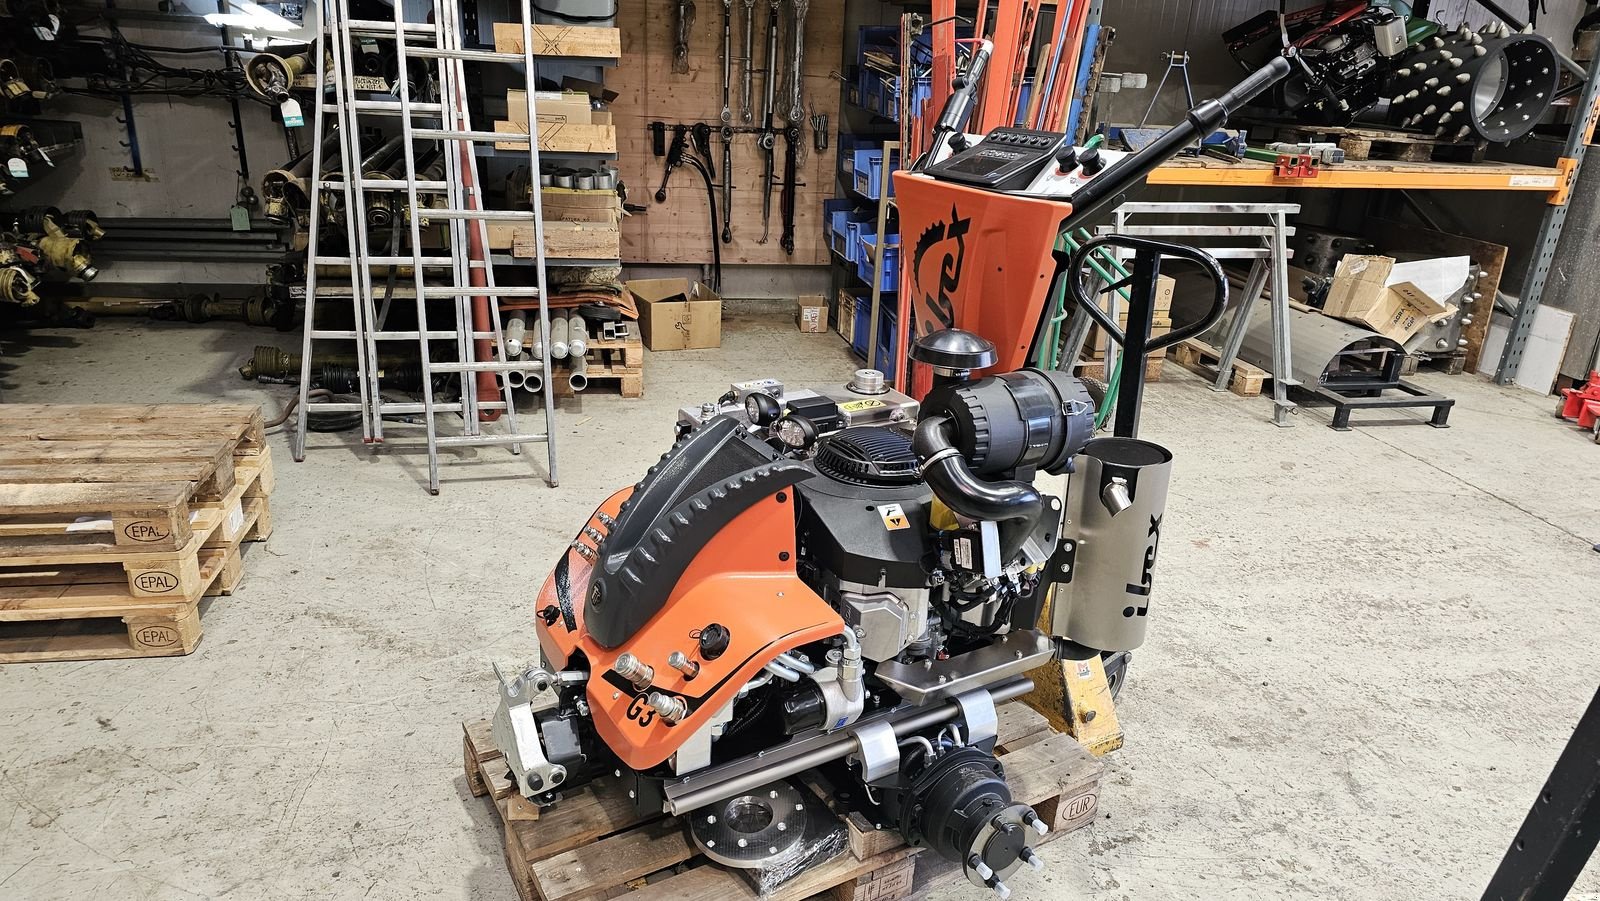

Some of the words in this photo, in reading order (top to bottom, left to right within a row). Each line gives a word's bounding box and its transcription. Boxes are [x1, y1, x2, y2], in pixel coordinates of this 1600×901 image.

[132, 526, 165, 538] EPAL
[140, 576, 173, 588] EPAL
[143, 631, 175, 643] EPAL
[627, 693, 657, 727] G3
[1068, 796, 1090, 818] EUR
